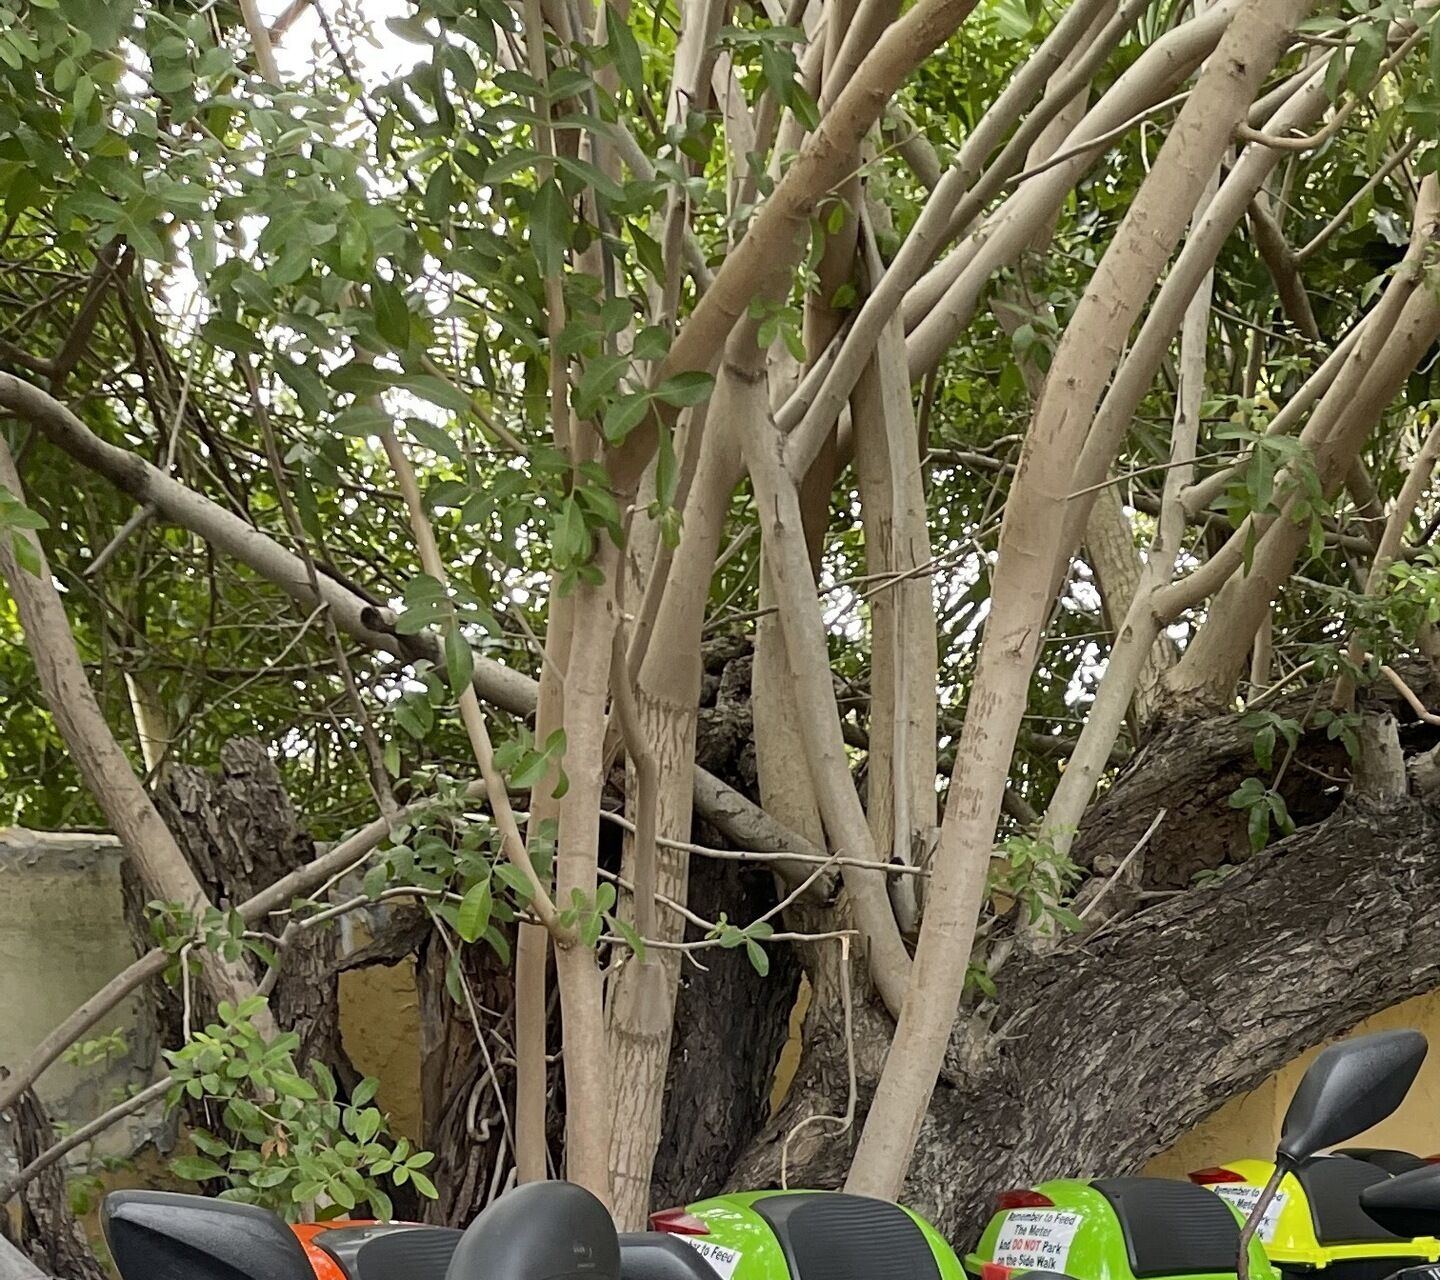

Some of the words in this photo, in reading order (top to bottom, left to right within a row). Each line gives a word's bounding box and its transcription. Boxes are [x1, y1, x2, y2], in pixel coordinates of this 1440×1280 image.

[1214, 1185, 1251, 1196] Remember
[1251, 1188, 1260, 1197] to
[1236, 1198, 1257, 1210] Mete
[1008, 1212, 1043, 1222] Remember
[1043, 1213, 1054, 1223] to
[1054, 1213, 1077, 1226] Feed
[1014, 1224, 1027, 1236] The
[1028, 1224, 1053, 1237] Meter
[701, 1243, 710, 1256] to
[711, 1246, 736, 1263] Feed
[998, 1239, 1011, 1251] And
[1011, 1238, 1023, 1251] DO
[1023, 1239, 1042, 1252] NOT
[1042, 1240, 1063, 1255] Park
[1006, 1254, 1017, 1266] the
[1018, 1254, 1035, 1267] Side
[1036, 1256, 1057, 1269] Walk
